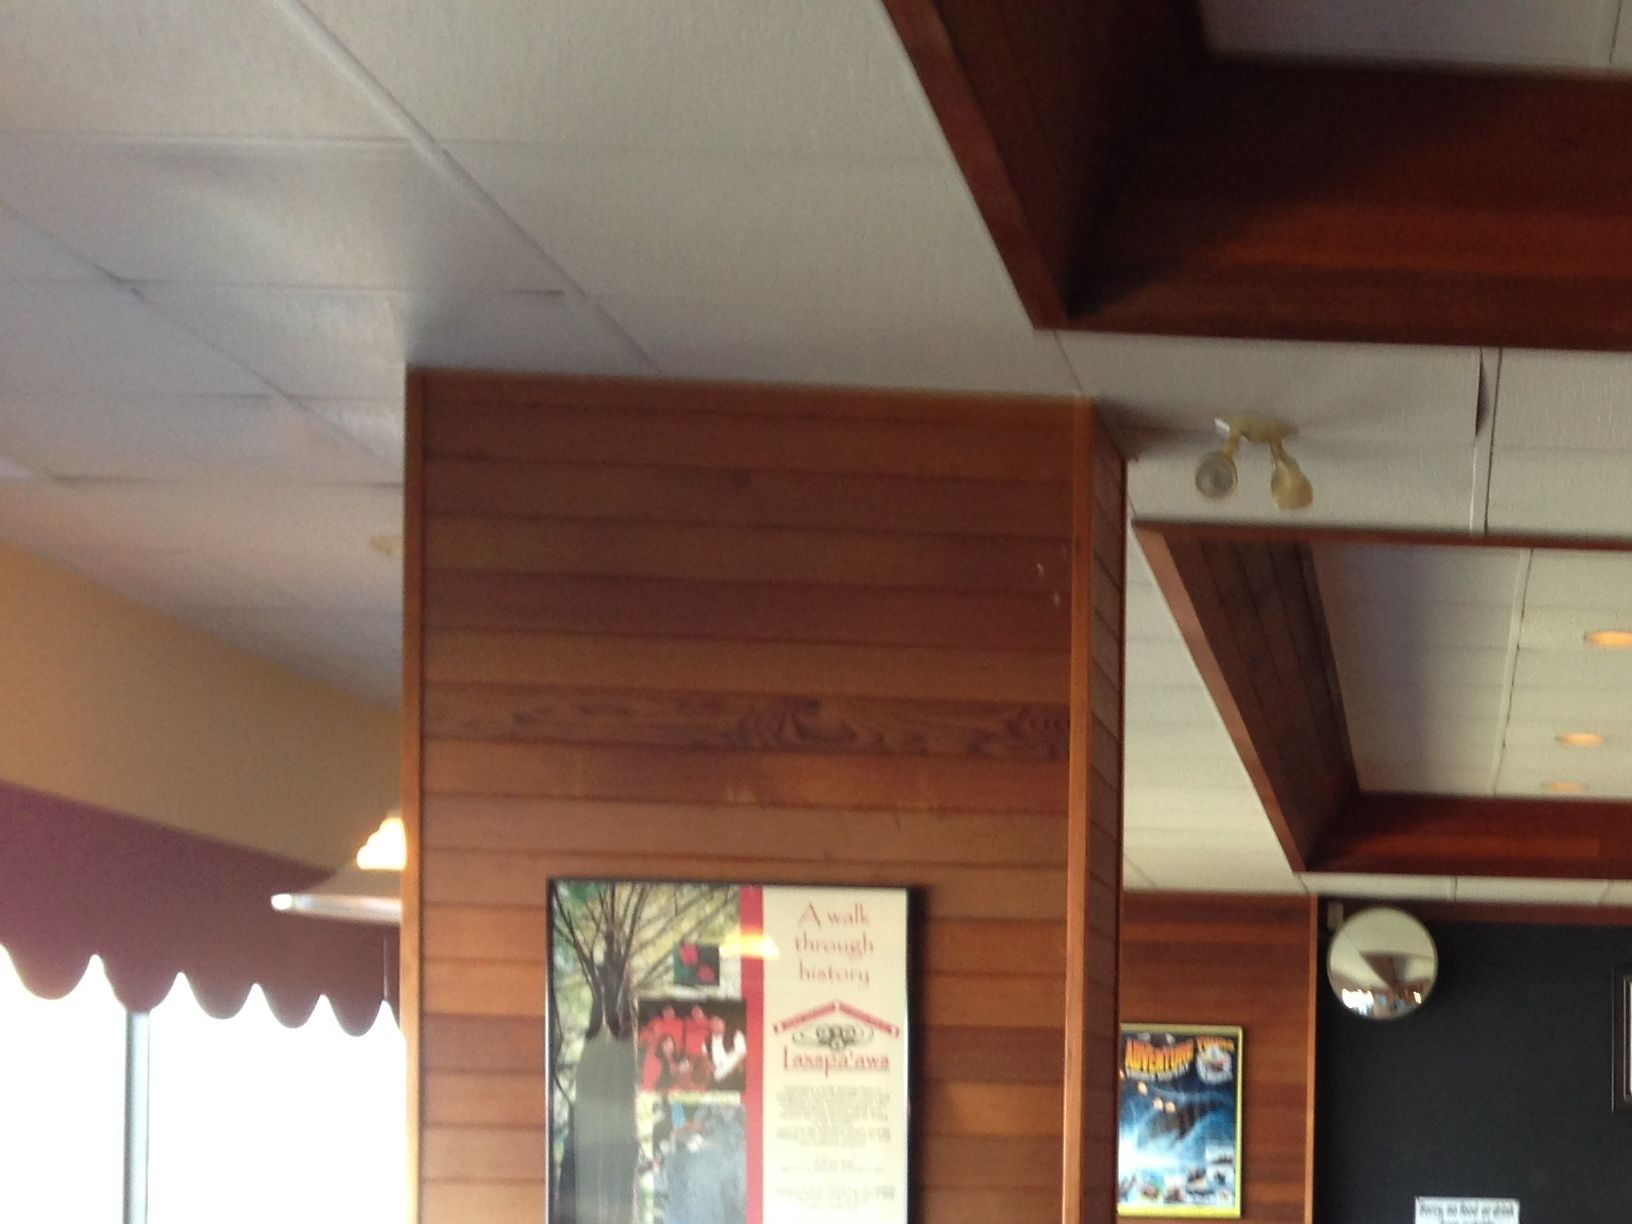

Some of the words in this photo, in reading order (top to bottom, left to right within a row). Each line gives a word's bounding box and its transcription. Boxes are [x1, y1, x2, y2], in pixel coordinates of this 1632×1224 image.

[799, 902, 821, 928] A
[827, 903, 870, 926] walk
[795, 931, 874, 960] through
[799, 958, 870, 987] history
